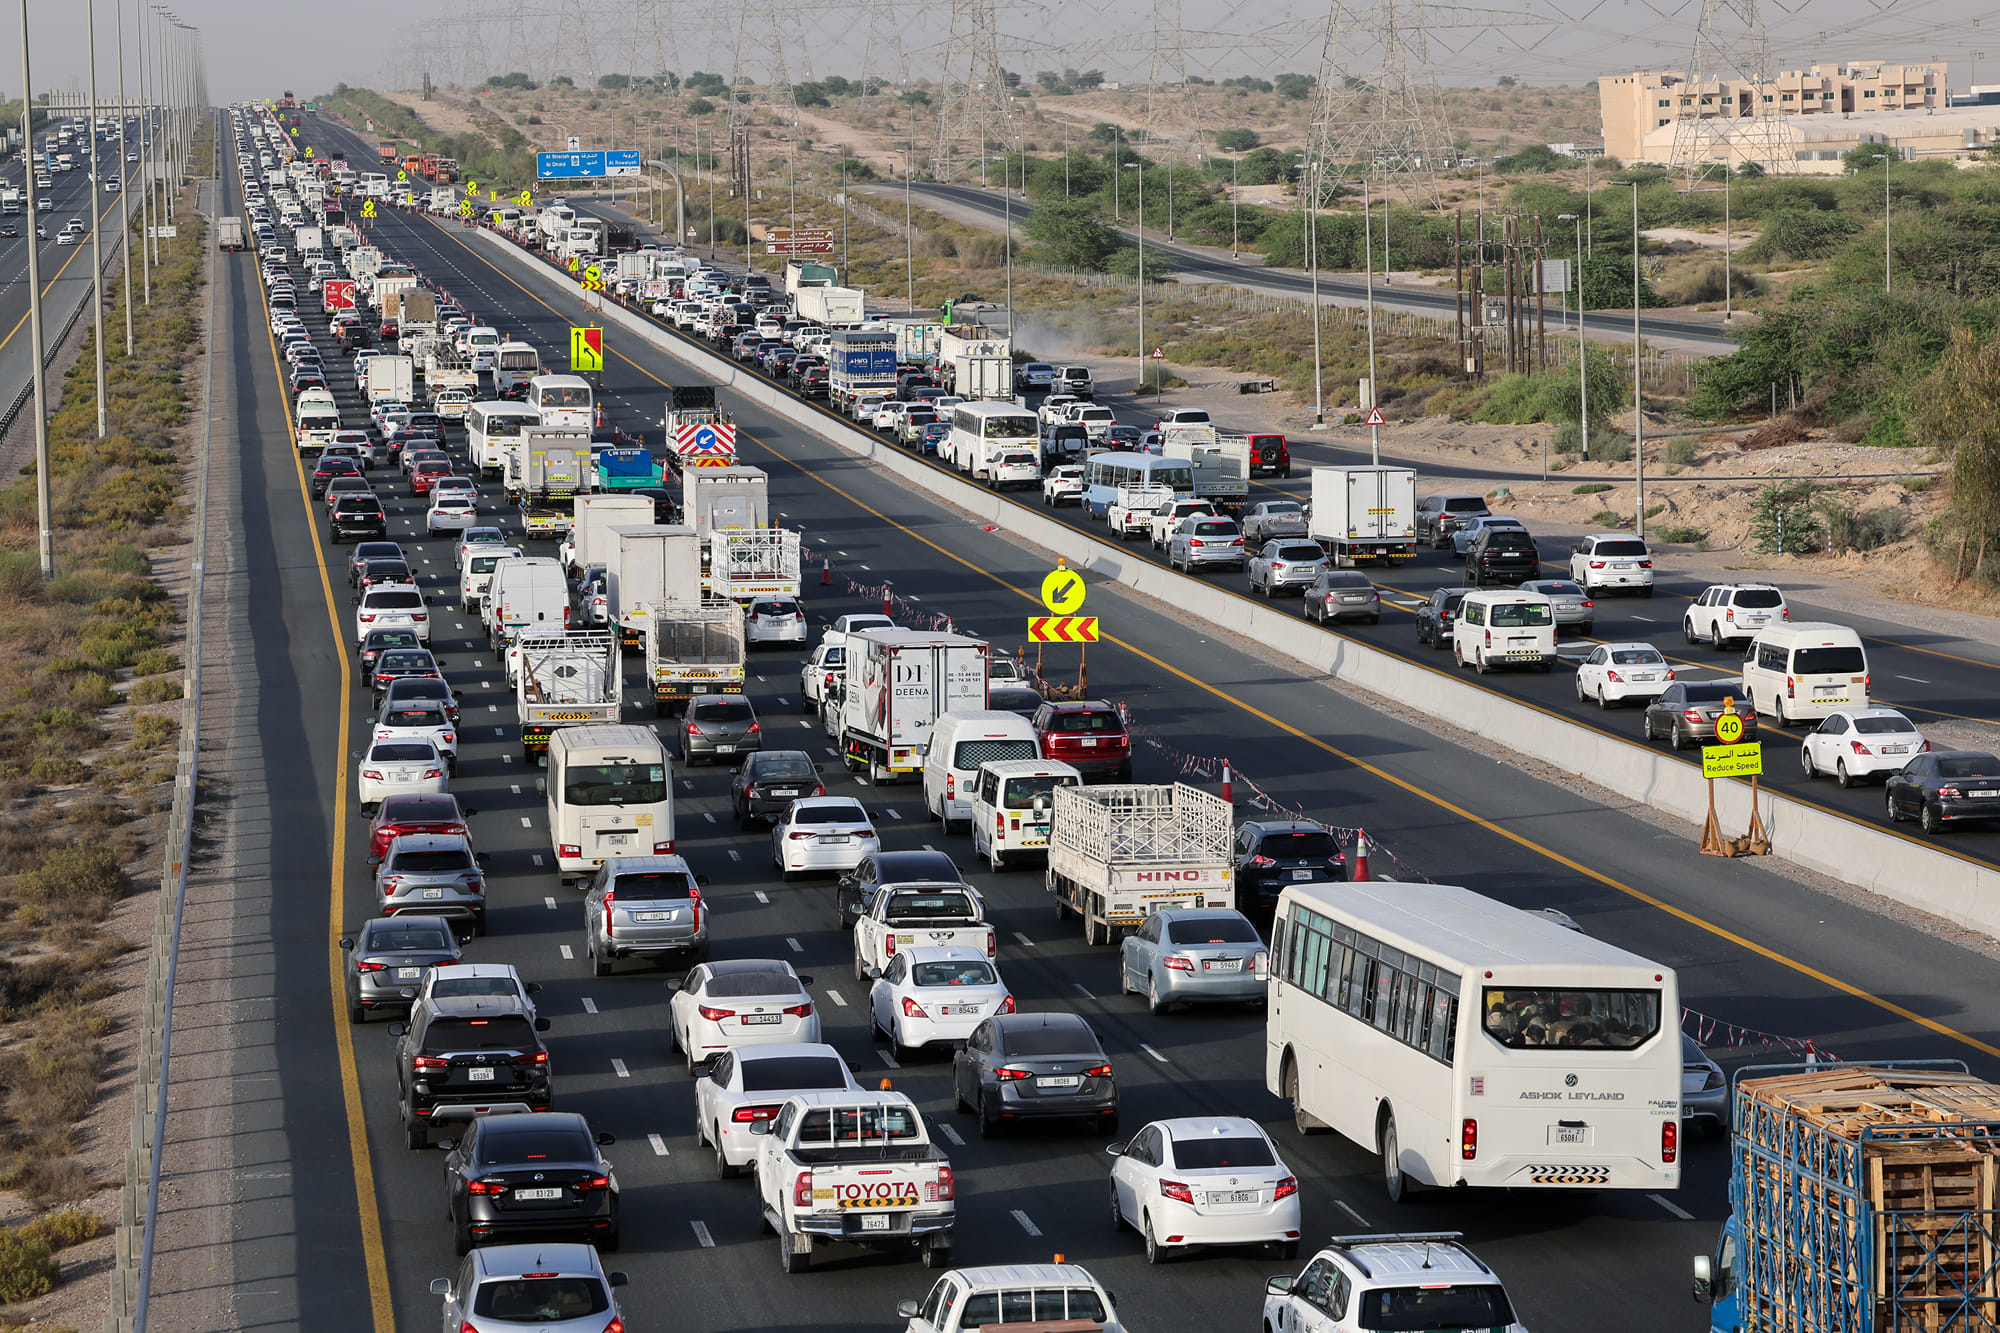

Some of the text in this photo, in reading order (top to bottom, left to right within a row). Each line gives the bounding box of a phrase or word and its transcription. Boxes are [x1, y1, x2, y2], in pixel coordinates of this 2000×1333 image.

[896, 688, 929, 696] DEENA
[1721, 722, 1738, 733] 40
[1705, 748, 1759, 761] خفف السرعة
[1736, 761, 1759, 771] Speed
[1137, 870, 1200, 882] HINO
[1519, 1091, 1625, 1101] ASHOK LEYLAND
[1560, 1134, 1578, 1142] 65081
[832, 1182, 919, 1200] TOYOTA
[866, 1220, 885, 1229] 76475
